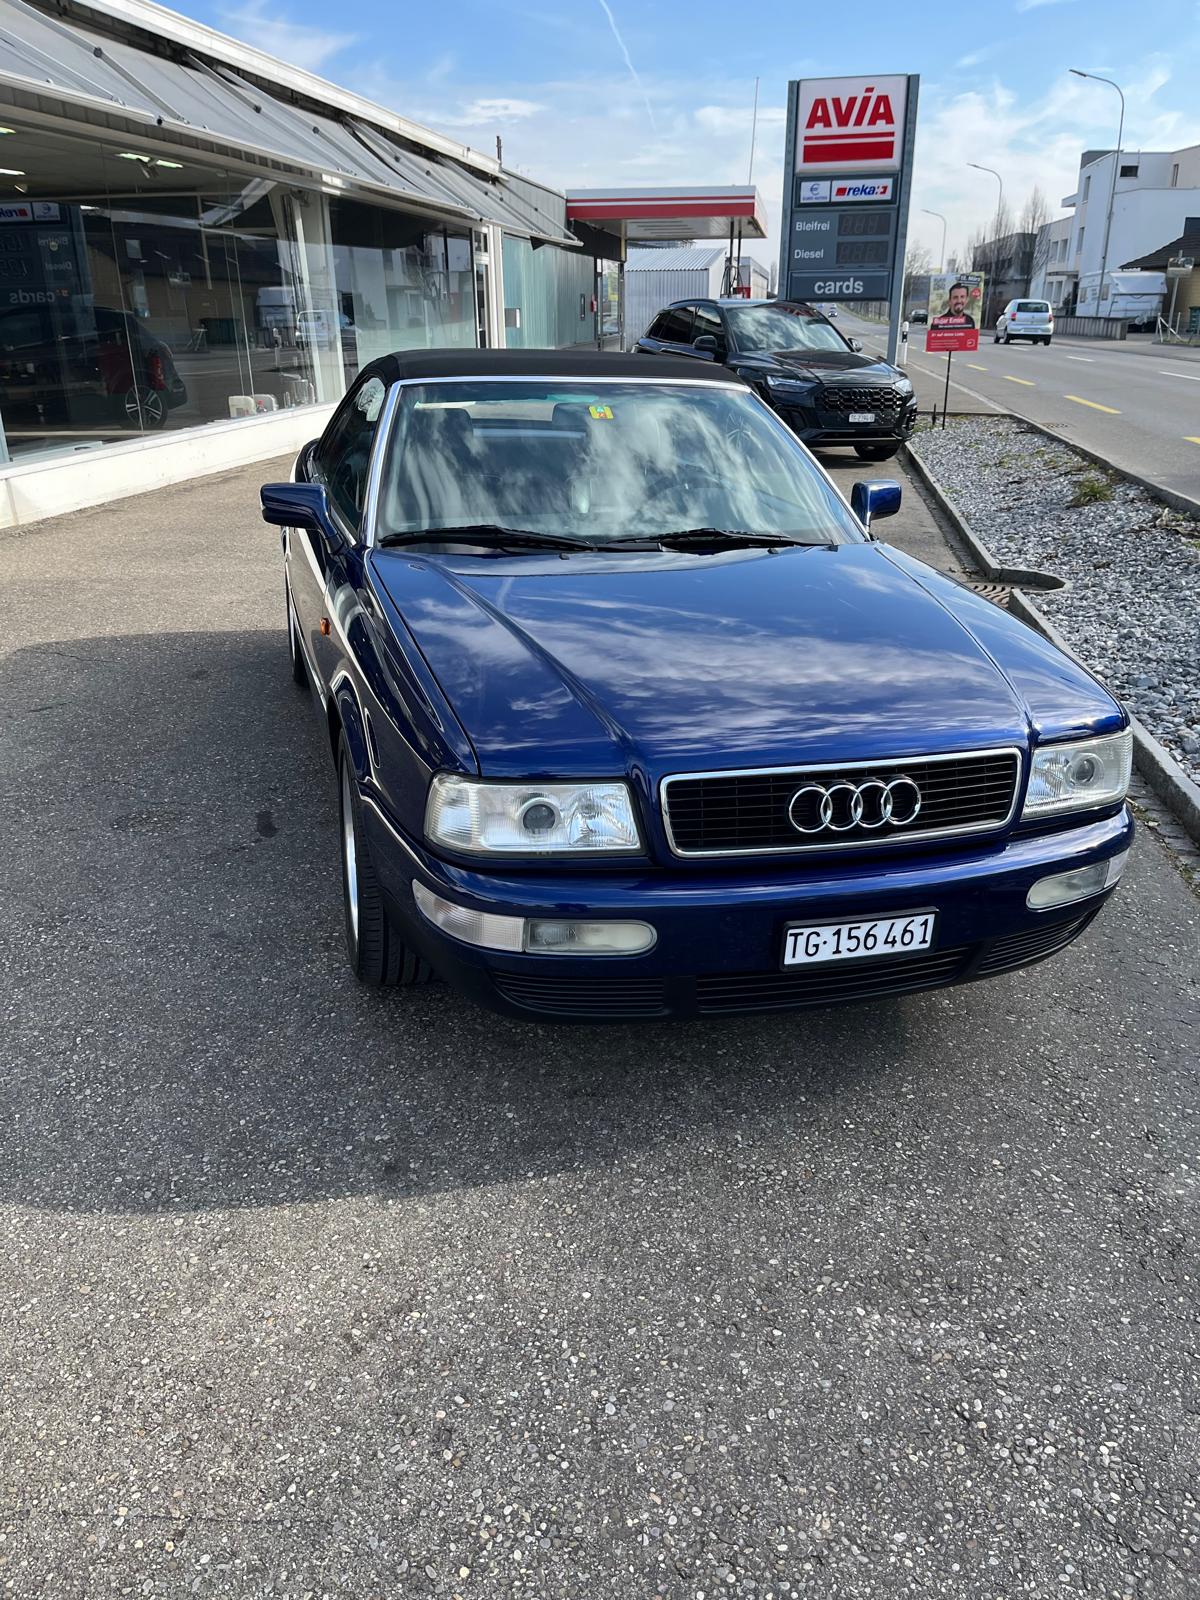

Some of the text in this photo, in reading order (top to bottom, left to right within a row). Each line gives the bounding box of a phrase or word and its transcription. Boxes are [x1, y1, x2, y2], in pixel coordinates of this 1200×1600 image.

[805, 86, 895, 129] AVIA
[795, 221, 830, 231] Bleifrei
[794, 249, 824, 259] Diesel
[814, 277, 864, 294] cards
